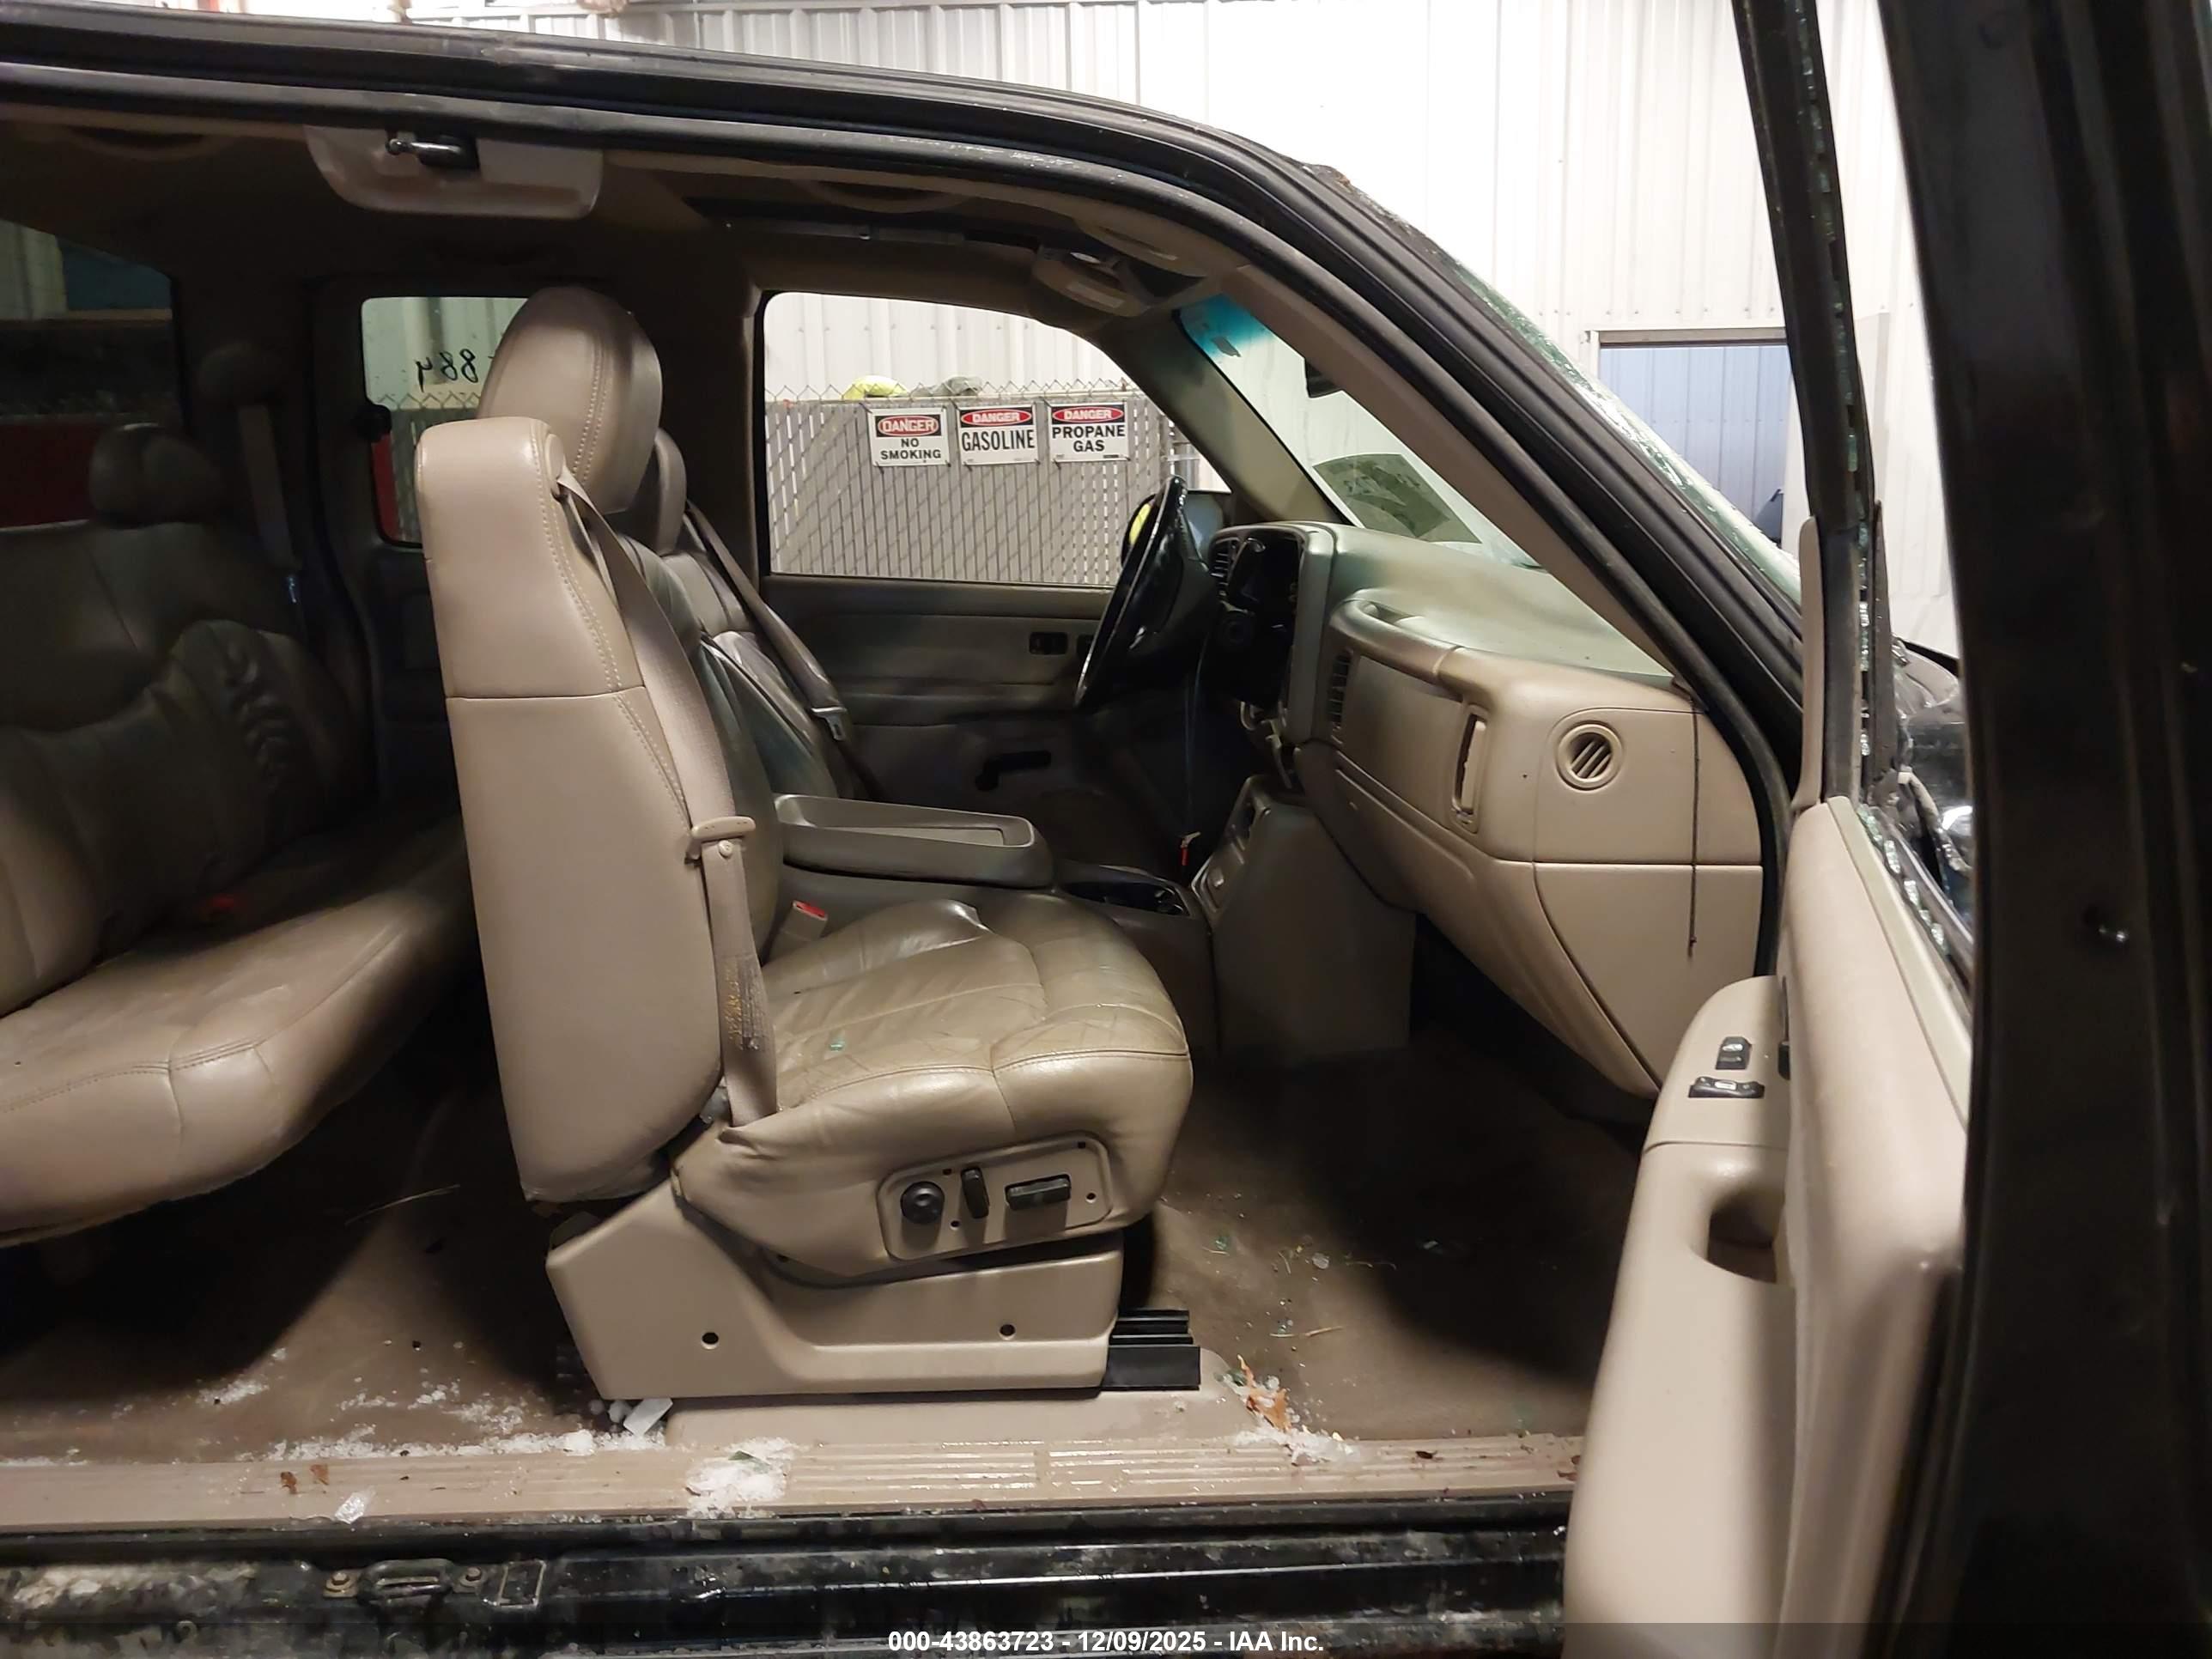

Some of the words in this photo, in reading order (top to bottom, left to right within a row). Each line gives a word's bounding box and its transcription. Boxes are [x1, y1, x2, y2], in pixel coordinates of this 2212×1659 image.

[972, 412, 1020, 423] DANGER
[1064, 410, 1112, 420] DANGER
[882, 419, 935, 433] DANGER
[1052, 424, 1126, 439] PROPANE
[901, 438, 920, 447] NO
[961, 429, 1036, 452] GASOLINE
[1073, 440, 1105, 453] GAS
[880, 449, 942, 460] SMOKING
